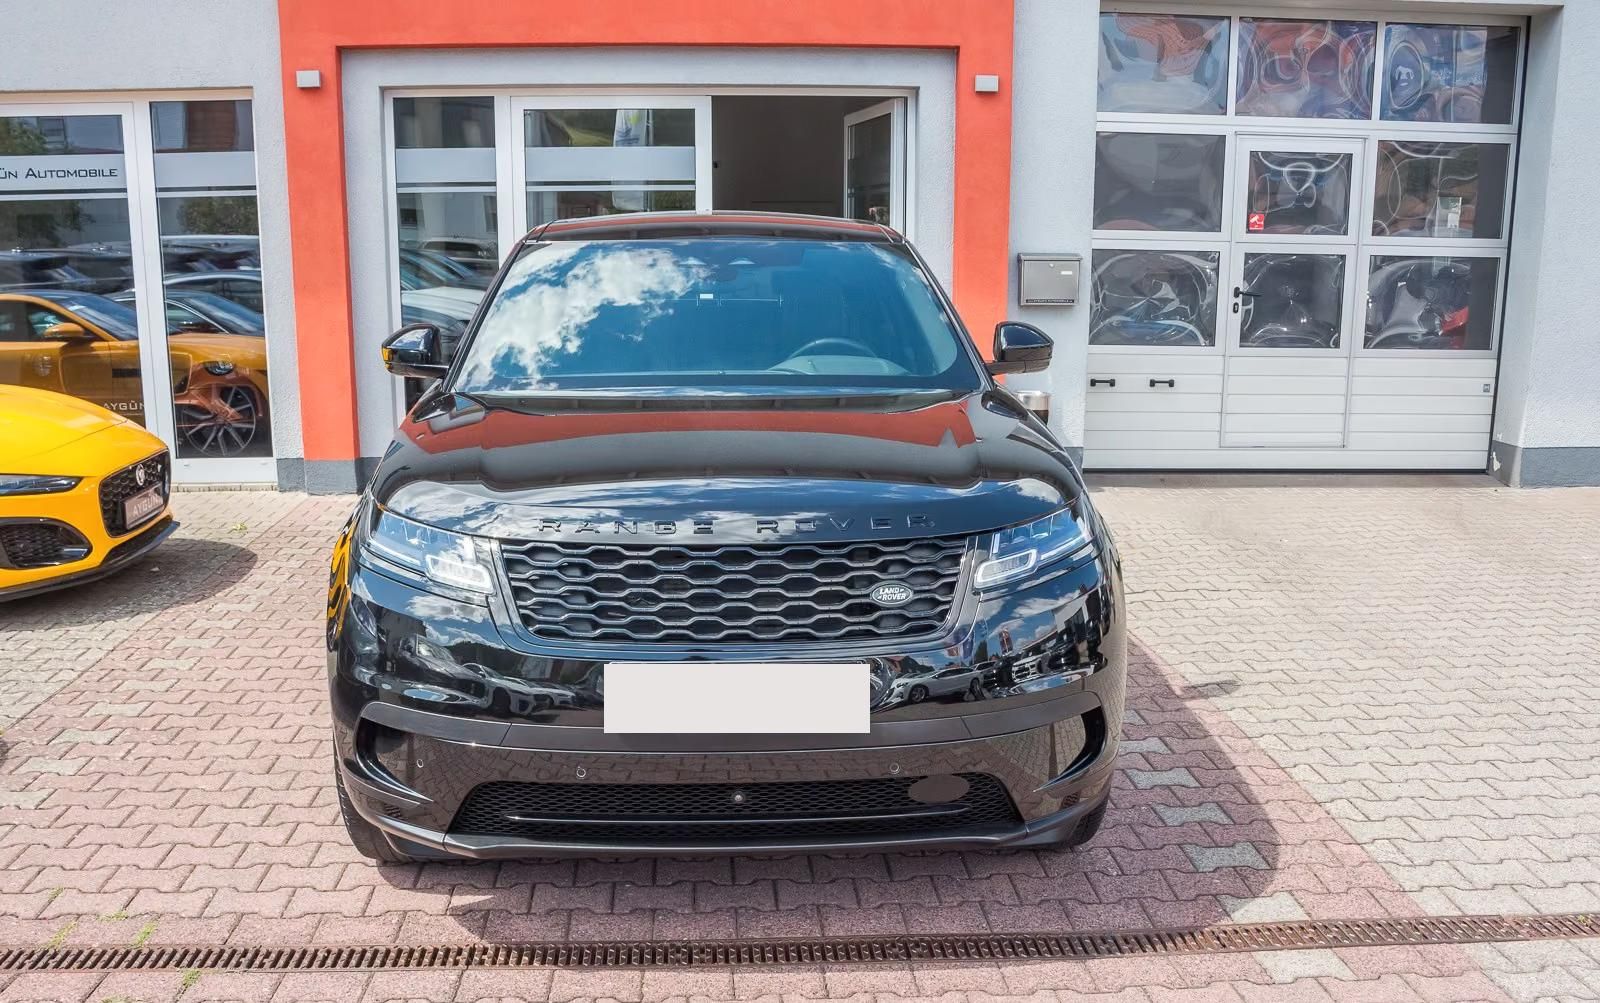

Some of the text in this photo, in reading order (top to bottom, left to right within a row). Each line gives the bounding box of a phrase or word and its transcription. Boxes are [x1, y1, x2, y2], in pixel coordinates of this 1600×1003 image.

[25, 168, 118, 179] AUTOMOBILE
[537, 512, 936, 535] RANGE ROVER
[880, 587, 900, 595] LAND
